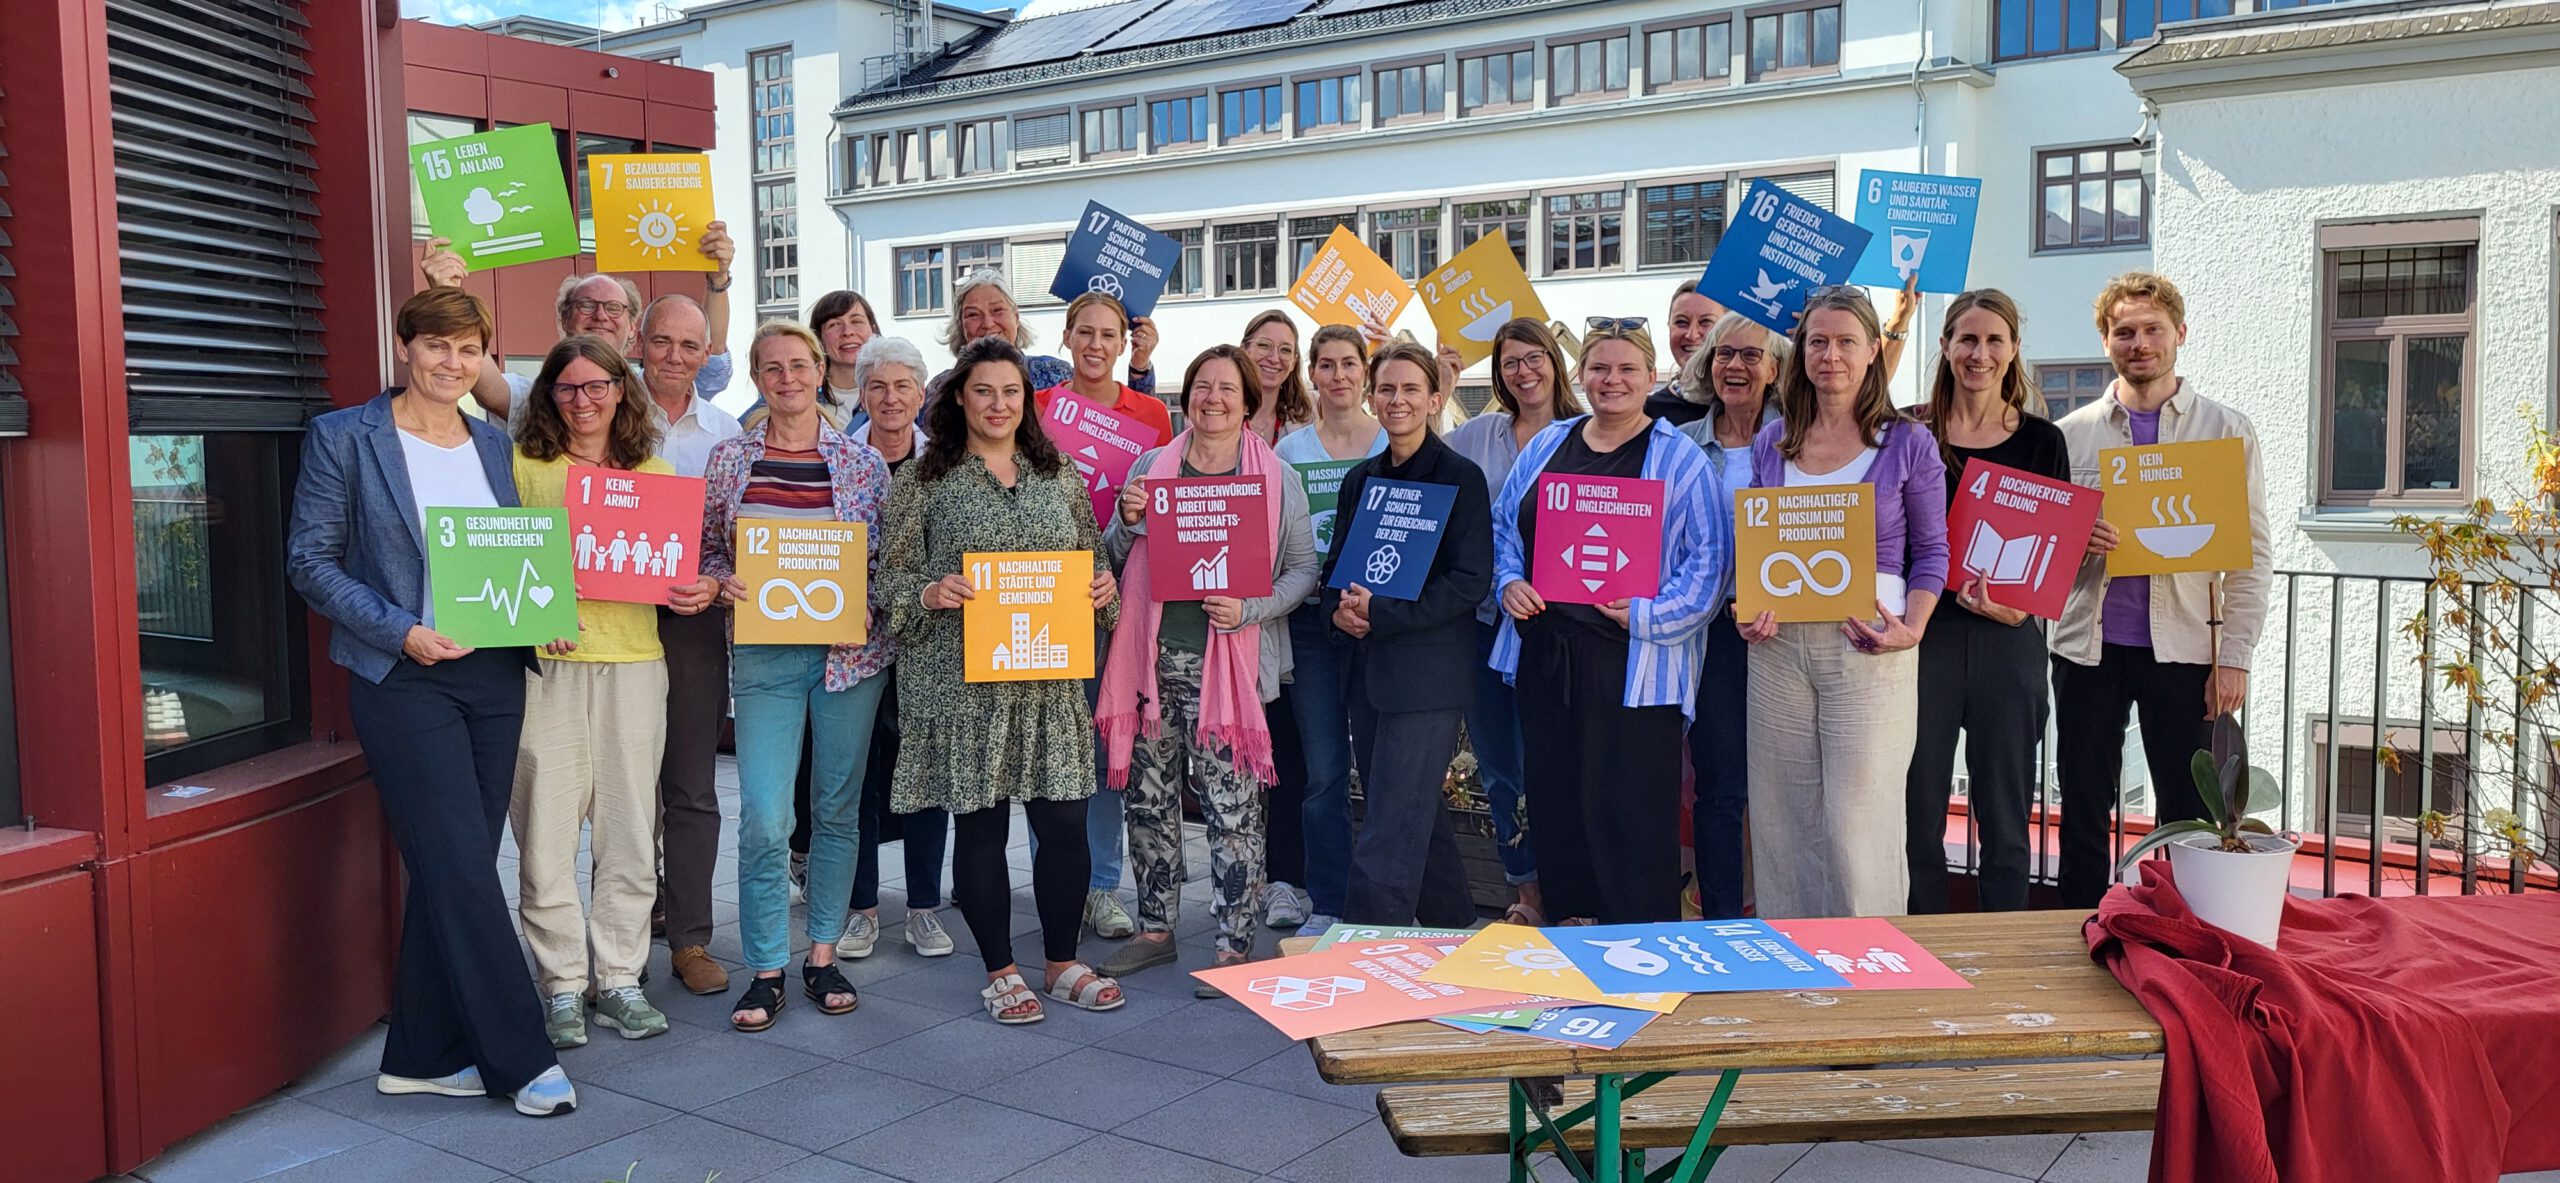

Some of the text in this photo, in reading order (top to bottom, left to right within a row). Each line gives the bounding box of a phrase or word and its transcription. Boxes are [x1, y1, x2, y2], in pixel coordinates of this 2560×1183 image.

[454, 142, 488, 160] LEBEN
[422, 149, 452, 182] 15
[460, 156, 504, 176] AN LAND
[624, 163, 700, 176] BEZAHLBARE UND
[601, 164, 614, 190] 7
[626, 176, 703, 190] SAUBERE ENERGIE
[1868, 177, 1882, 204] 6
[1892, 180, 1976, 198] SAUBERES WASSER
[1749, 190, 1779, 222] 16
[1890, 194, 1950, 210] UND SANITÄR-
[1088, 210, 1110, 235] 17
[1783, 202, 1820, 232] FRIEDEN,
[1888, 208, 1957, 225] EINRICHTUNGEN
[1112, 220, 1148, 243] PARTNER-
[1775, 218, 1845, 258] GERECHTIGKEIT
[1107, 232, 1146, 257] SCHAFTEN
[1768, 232, 1790, 250] UND
[1096, 254, 1132, 278] DER ZIELE
[1102, 242, 1162, 279] ZUR ERREICHUNG
[1331, 259, 1346, 275] UND
[1760, 245, 1826, 284] INSTITUTIONEN
[1296, 286, 1320, 310] 11
[1426, 282, 1441, 304] 2
[1052, 396, 1078, 424] 10
[1083, 407, 1120, 431] WENIGER
[1078, 420, 1142, 456] UNGLEICHHEITEN
[2138, 453, 2163, 466] KEIN
[1308, 467, 1350, 480] MASSNAH
[2112, 456, 2128, 484] 2
[2140, 467, 2182, 482] HUNGER
[581, 476, 592, 504] 1
[605, 478, 636, 493] KEINE
[1175, 483, 1262, 498] MENSCHENWÜRDIGE
[1577, 484, 1618, 499] WENIGER
[1969, 470, 1990, 500] 4
[1998, 475, 2073, 506] HOCHWERTIGE
[603, 494, 640, 509] ARMUT
[1154, 487, 1169, 514] 8
[1366, 485, 1386, 510] 17
[1389, 487, 1423, 502] PARTNER-
[1546, 482, 1569, 511] 10
[1778, 492, 1858, 510] NACHHALTIGE/R
[1993, 490, 2038, 514] BILDUNG
[1176, 500, 1226, 514] ARBEIT UND
[1385, 500, 1421, 515] SCHAFTEN
[1576, 500, 1652, 518] UNGLEICHHEITEN
[1744, 496, 1769, 527] 12
[466, 517, 552, 530] GESUNDHEIT UND
[1176, 514, 1240, 528] WIRTSCHAFTS-
[1380, 514, 1438, 532] ZUR ERREICHUNG
[1778, 510, 1844, 526] KONSUM UND
[439, 516, 456, 548] 3
[468, 534, 544, 547] WOHLERGEHEN
[746, 527, 770, 554] 12
[778, 528, 854, 543] NACHHALTIGE/R
[1178, 530, 1228, 543] WACHSTUM
[1375, 528, 1408, 542] DER ZIELE
[1779, 526, 1844, 542] PRODUKTION
[778, 543, 840, 556] KONSUM UND
[778, 558, 840, 570] PRODUKTION
[998, 560, 1062, 573] NACHHALTIGE
[972, 562, 991, 590] 11
[999, 575, 1056, 589] STÄDTE UND
[1000, 591, 1052, 604] GEMEINDEN
[1704, 923, 1762, 936] 14
[1360, 944, 1410, 955] 9
[1725, 940, 1770, 962] WASSER
[1752, 939, 1787, 956] LEBEN
[1349, 960, 1436, 1000] INFRASTRUKTUR
[1560, 1017, 1618, 1039] 16
